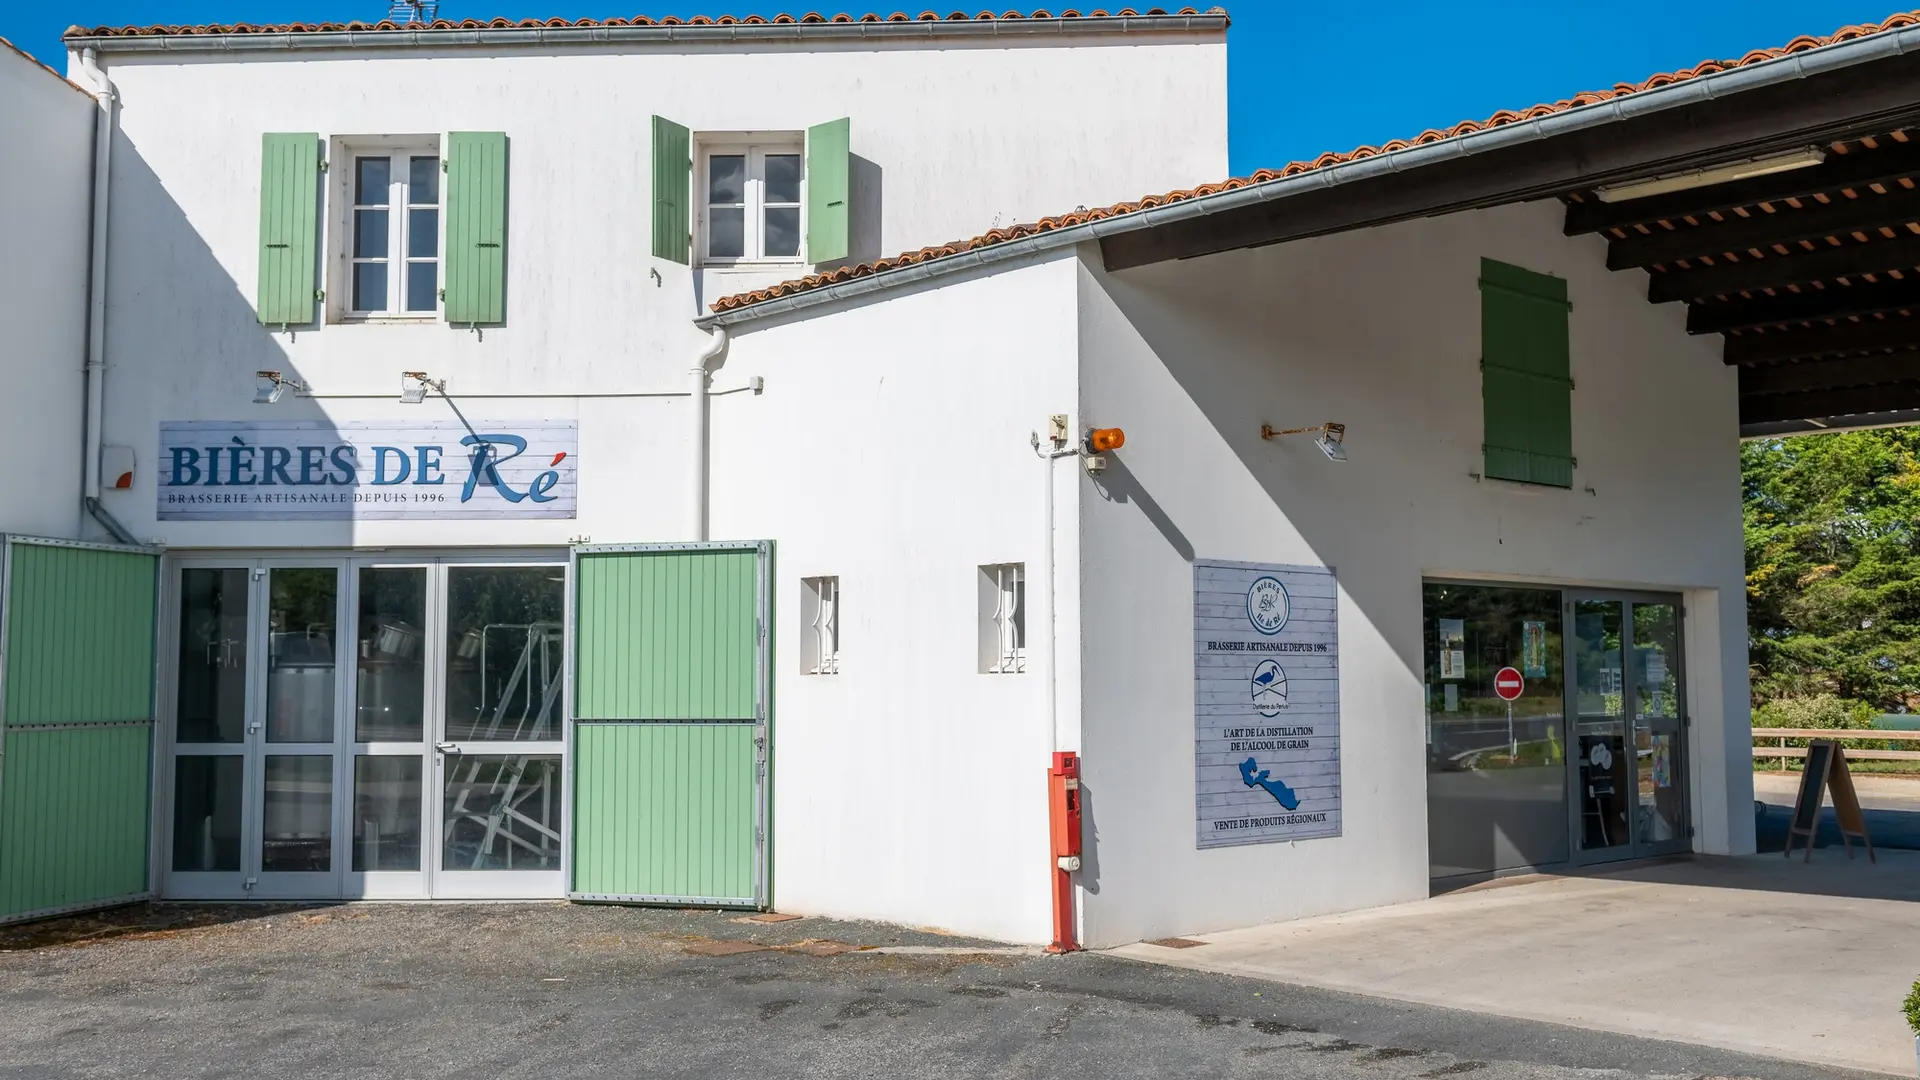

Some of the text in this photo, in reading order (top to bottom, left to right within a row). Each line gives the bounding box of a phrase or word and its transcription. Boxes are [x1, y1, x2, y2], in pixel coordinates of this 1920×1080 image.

[168, 433, 567, 503] BIÈRES DE Ré
[168, 493, 445, 504] BRASSERIE ARTISANALE DEPUIS 1996
[1257, 581, 1280, 594] BIÈRES
[1266, 618, 1272, 627] de
[1273, 612, 1280, 624] Ré
[1208, 642, 1328, 652] BRASSERIE ARTISANALE DEPUIS 1996
[1224, 726, 1313, 738] L'ART DE LA DISTILLATION
[1231, 740, 1309, 751] DE L'ALCOOL DE GRAIN
[1214, 813, 1326, 830] VENTE DE PRODUITS RÉGIONAUX
